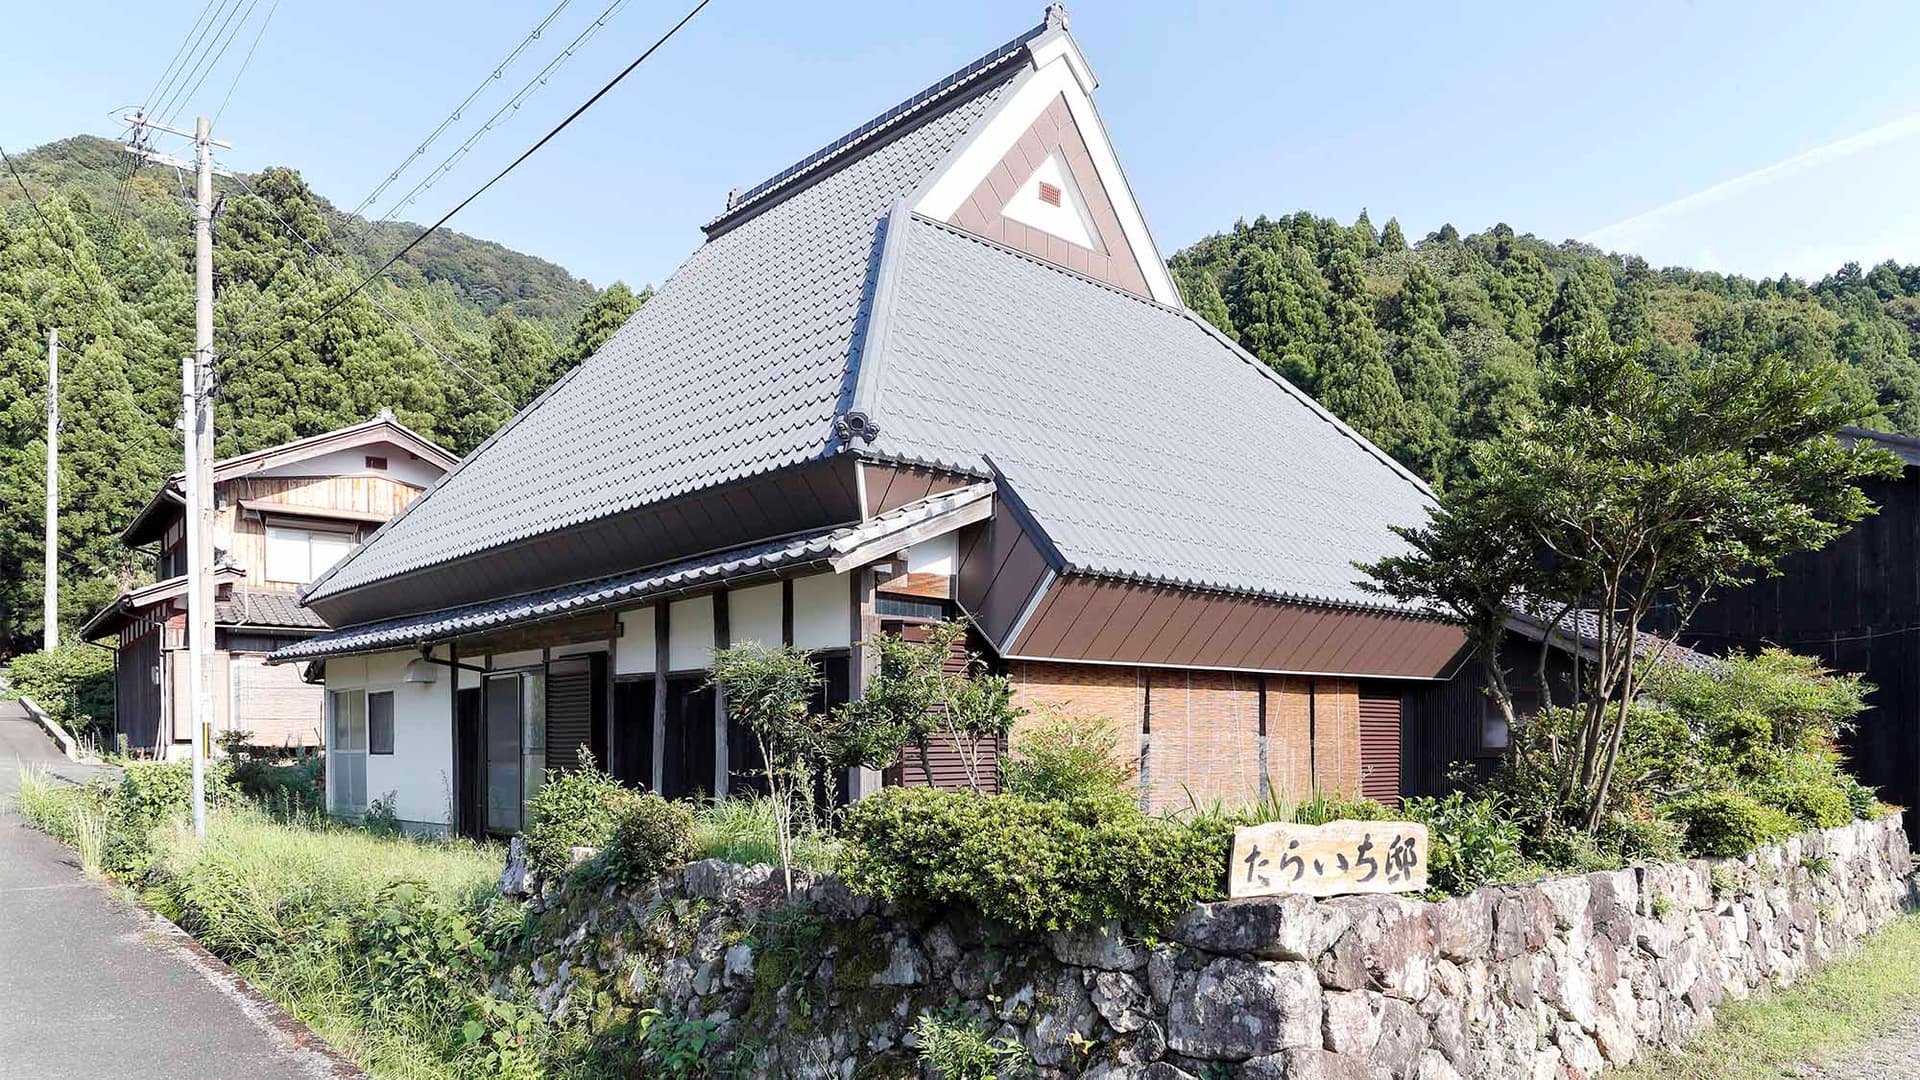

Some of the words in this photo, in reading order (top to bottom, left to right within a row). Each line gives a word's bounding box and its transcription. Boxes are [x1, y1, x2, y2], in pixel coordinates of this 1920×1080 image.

[1244, 833, 1417, 886] たらいち邸
